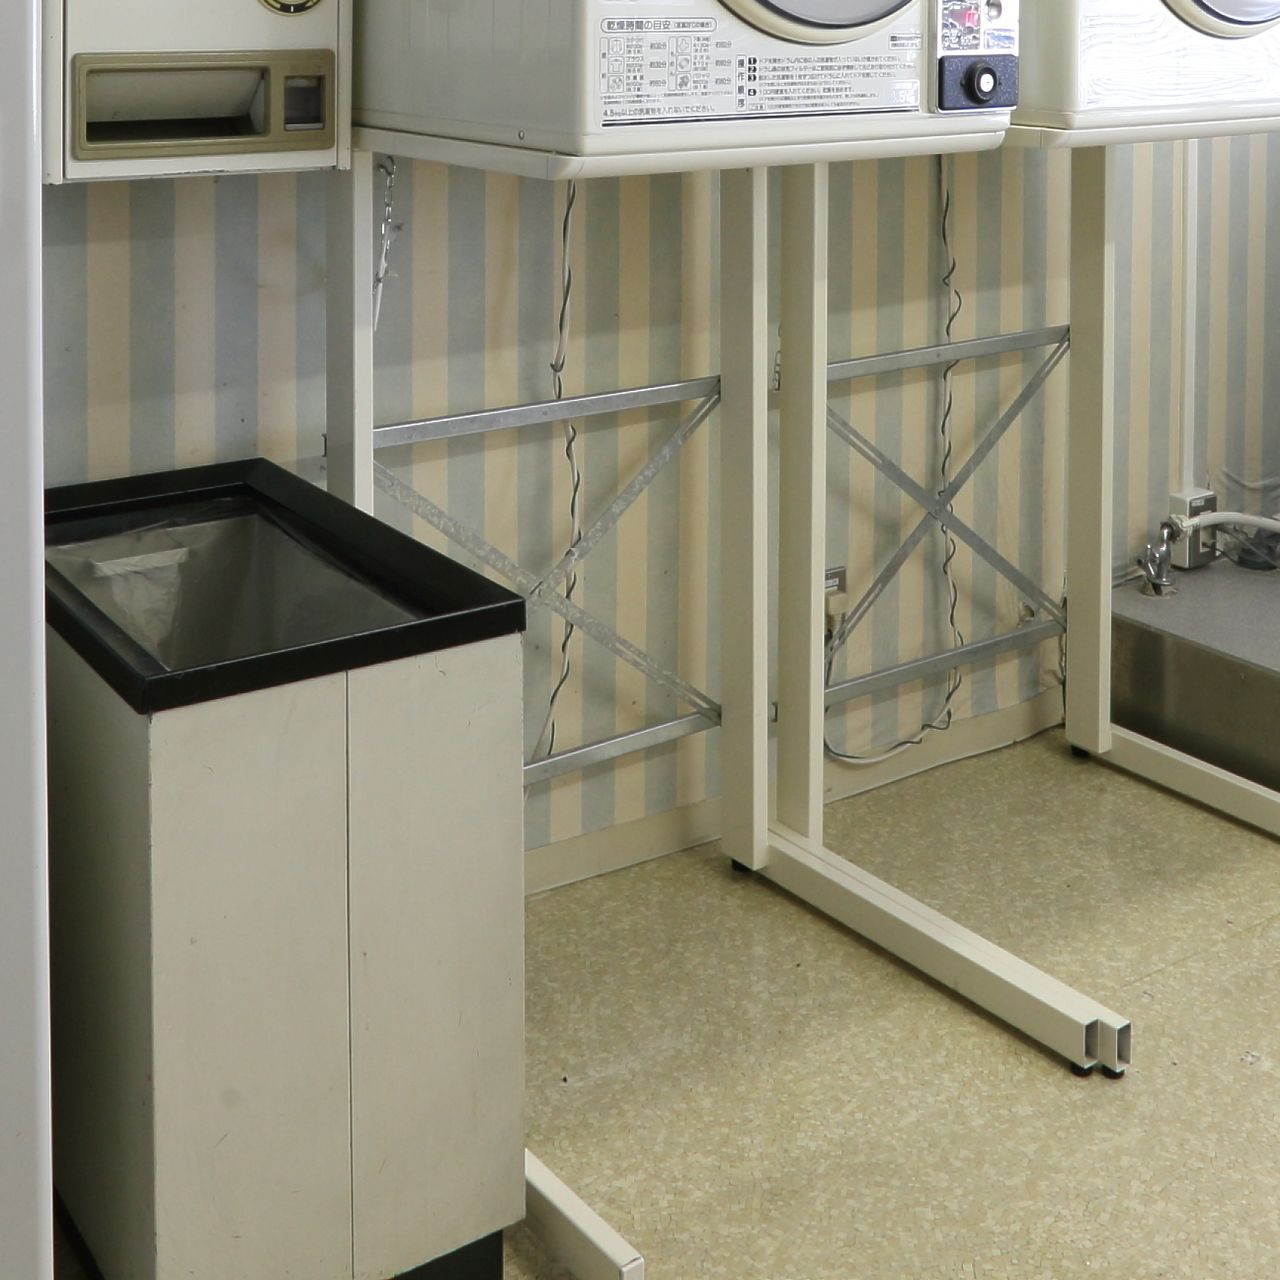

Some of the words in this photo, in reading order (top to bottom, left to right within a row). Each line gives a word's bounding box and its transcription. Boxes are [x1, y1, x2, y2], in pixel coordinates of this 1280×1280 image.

[606, 19, 671, 31] 乾燥時間の目安
